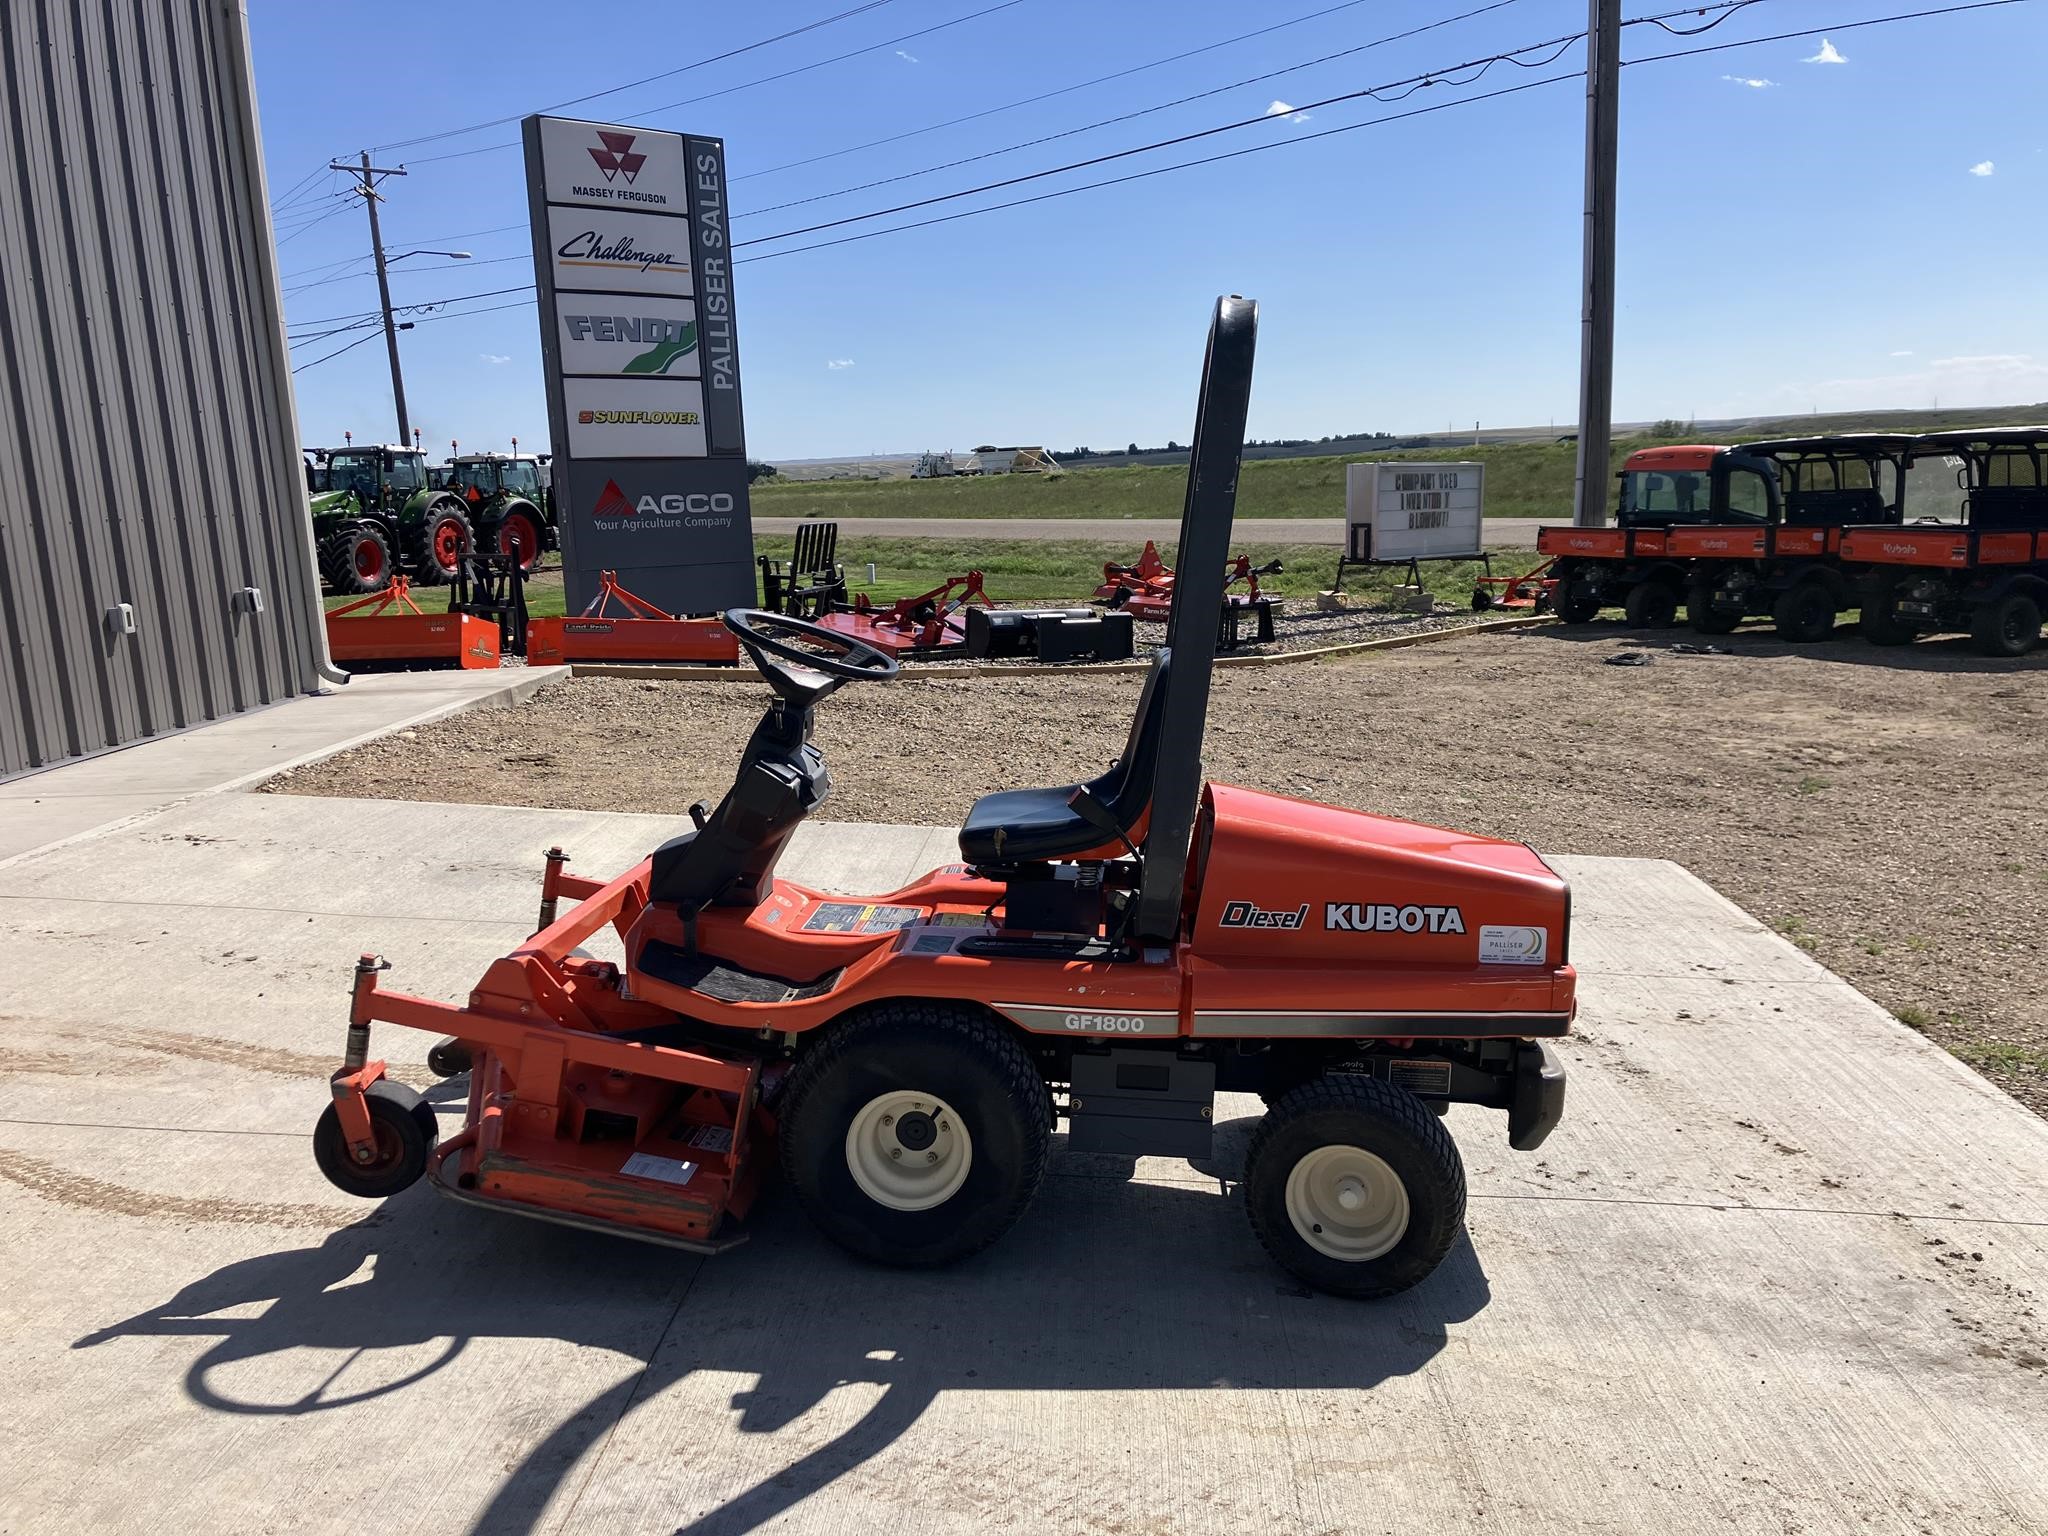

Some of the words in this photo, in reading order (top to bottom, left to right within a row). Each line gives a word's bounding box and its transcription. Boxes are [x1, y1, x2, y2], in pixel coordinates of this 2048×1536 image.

[572, 186, 614, 199] MASSEY
[617, 190, 667, 204] FERGUSON
[697, 154, 724, 248] SALES
[557, 231, 689, 272] Challenger
[564, 315, 690, 344] FENDT
[704, 257, 734, 390] PALLISER
[594, 411, 698, 424] SUNFLOWER
[1395, 473, 1436, 490] COMPACT
[1439, 472, 1458, 489] USED
[635, 493, 734, 514] AGCO
[1400, 491, 1450, 510] INVENTORY
[594, 520, 619, 531] Your
[622, 518, 681, 532] Agriculture
[684, 517, 732, 529] Company
[1883, 542, 1918, 554] Kubota
[1143, 607, 1160, 615] Farm
[1219, 900, 1310, 930] Diesel
[1325, 902, 1466, 934] KUBOTA
[1489, 941, 1524, 949] PALLISER
[1065, 1014, 1145, 1032] GF1800
